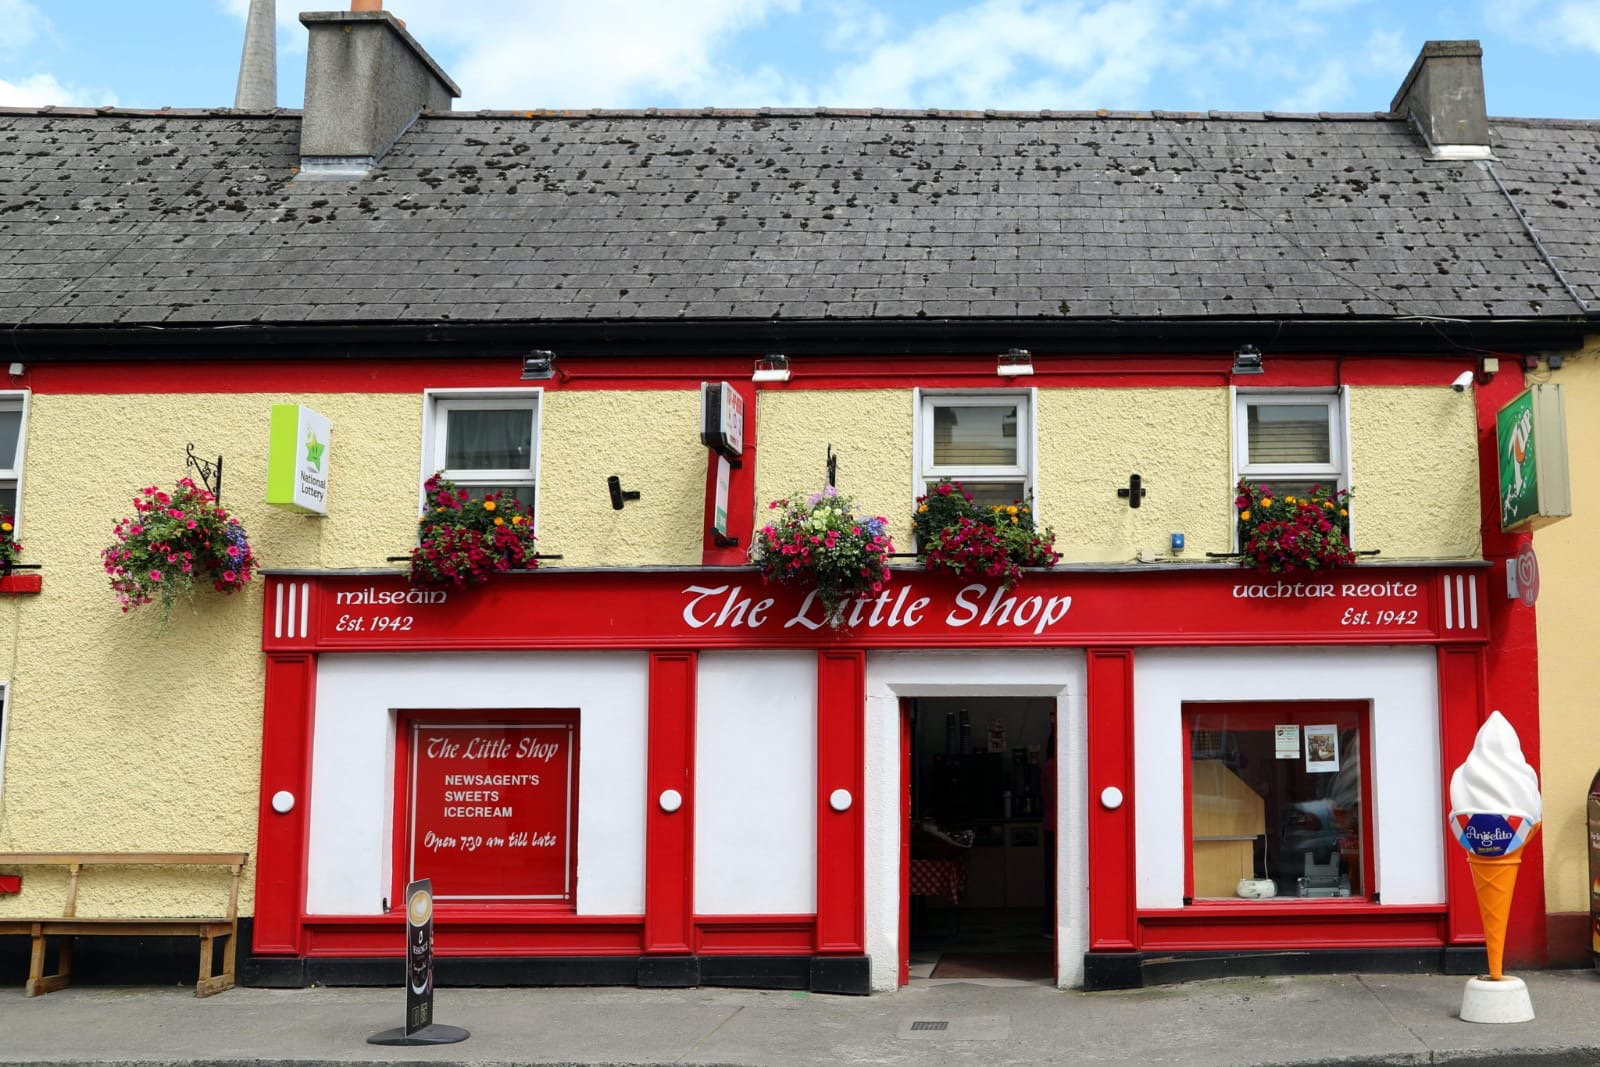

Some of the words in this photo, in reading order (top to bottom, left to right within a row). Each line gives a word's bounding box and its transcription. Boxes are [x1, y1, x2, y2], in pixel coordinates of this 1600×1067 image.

[300, 470, 326, 489] National
[301, 483, 324, 502] Lottery
[681, 584, 775, 628] The
[784, 584, 931, 630] Little
[945, 583, 1072, 635] Shop
[1341, 607, 1371, 625] Est.
[1375, 610, 1418, 625] 1942
[336, 614, 365, 631] Est.
[370, 616, 414, 631] 1942
[427, 737, 460, 759] The
[462, 737, 512, 759] Little
[516, 737, 559, 762] Shop
[444, 775, 540, 786] NEWSAGENT'S
[444, 791, 499, 801] SWEETS
[444, 807, 513, 818] ICECREAM
[424, 831, 457, 853] Open
[486, 838, 504, 848] am
[508, 832, 528, 847] till
[532, 832, 557, 847] late
[1466, 825, 1513, 847] Angelito
